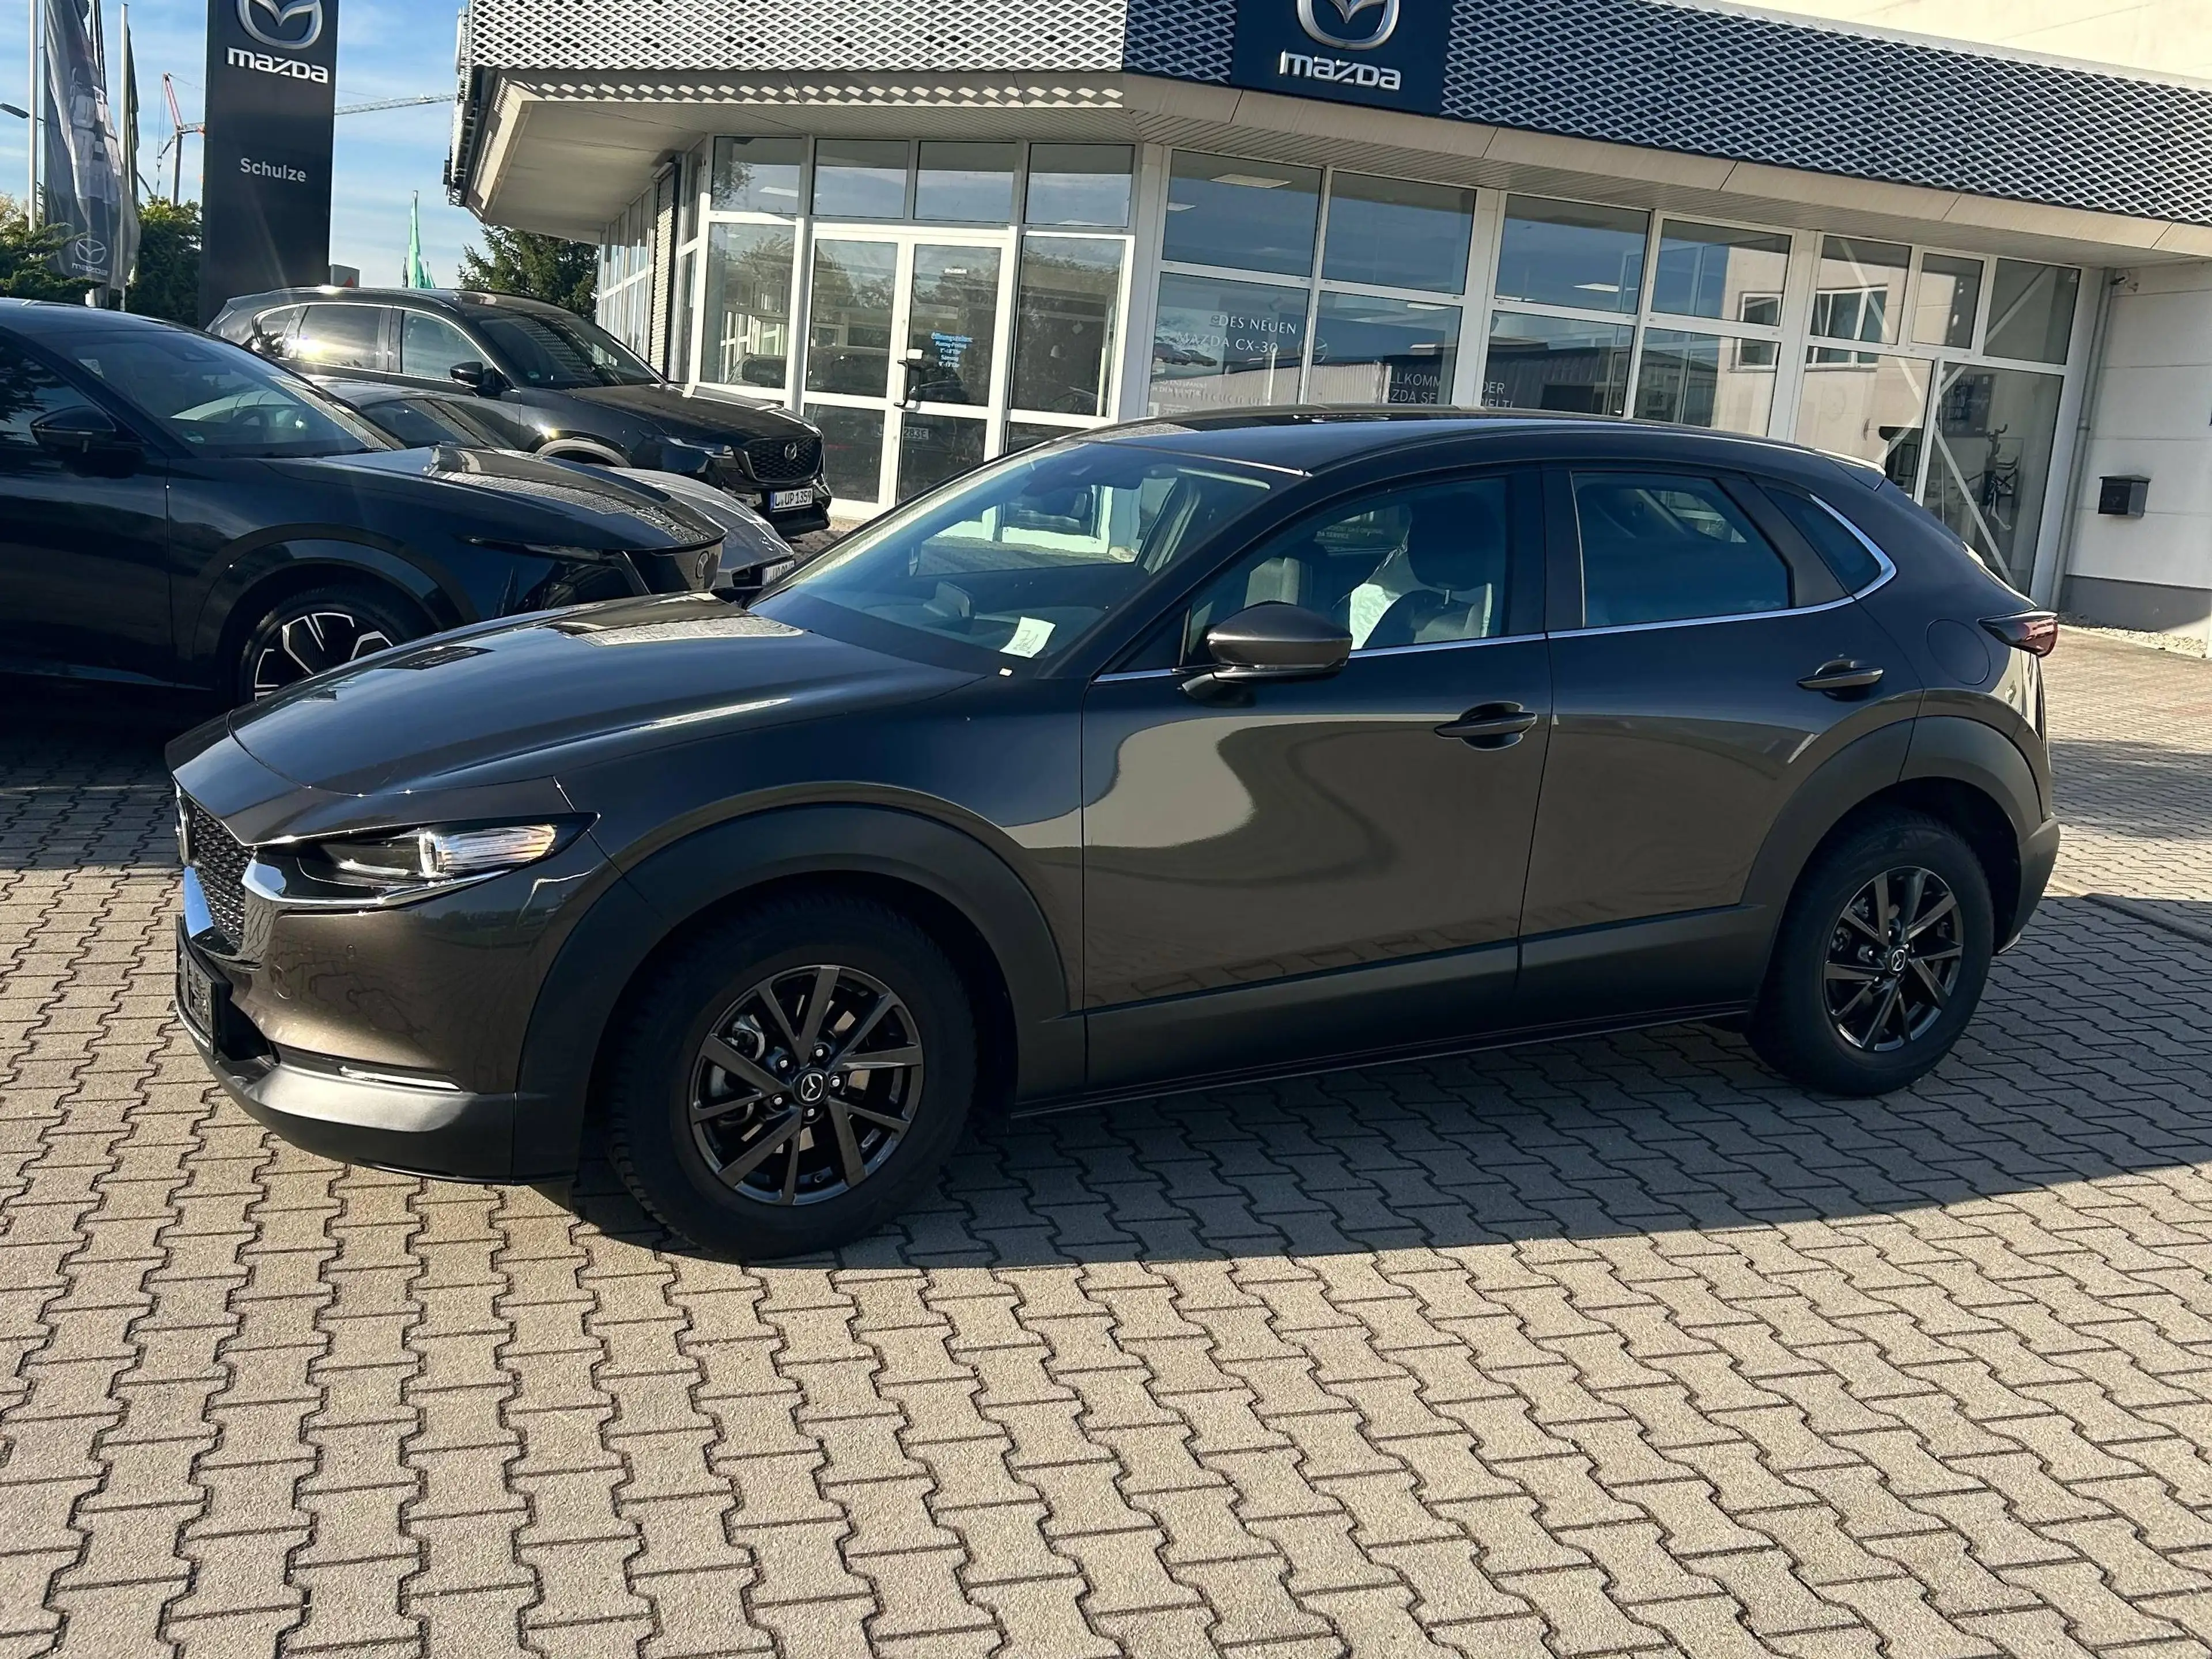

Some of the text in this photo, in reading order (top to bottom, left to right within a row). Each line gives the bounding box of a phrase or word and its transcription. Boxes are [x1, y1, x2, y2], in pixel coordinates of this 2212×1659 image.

[240, 157, 307, 183] Schulze
[1219, 315, 1296, 335] DES NEUEN
[1175, 332, 1279, 354] MAZDA CX-30
